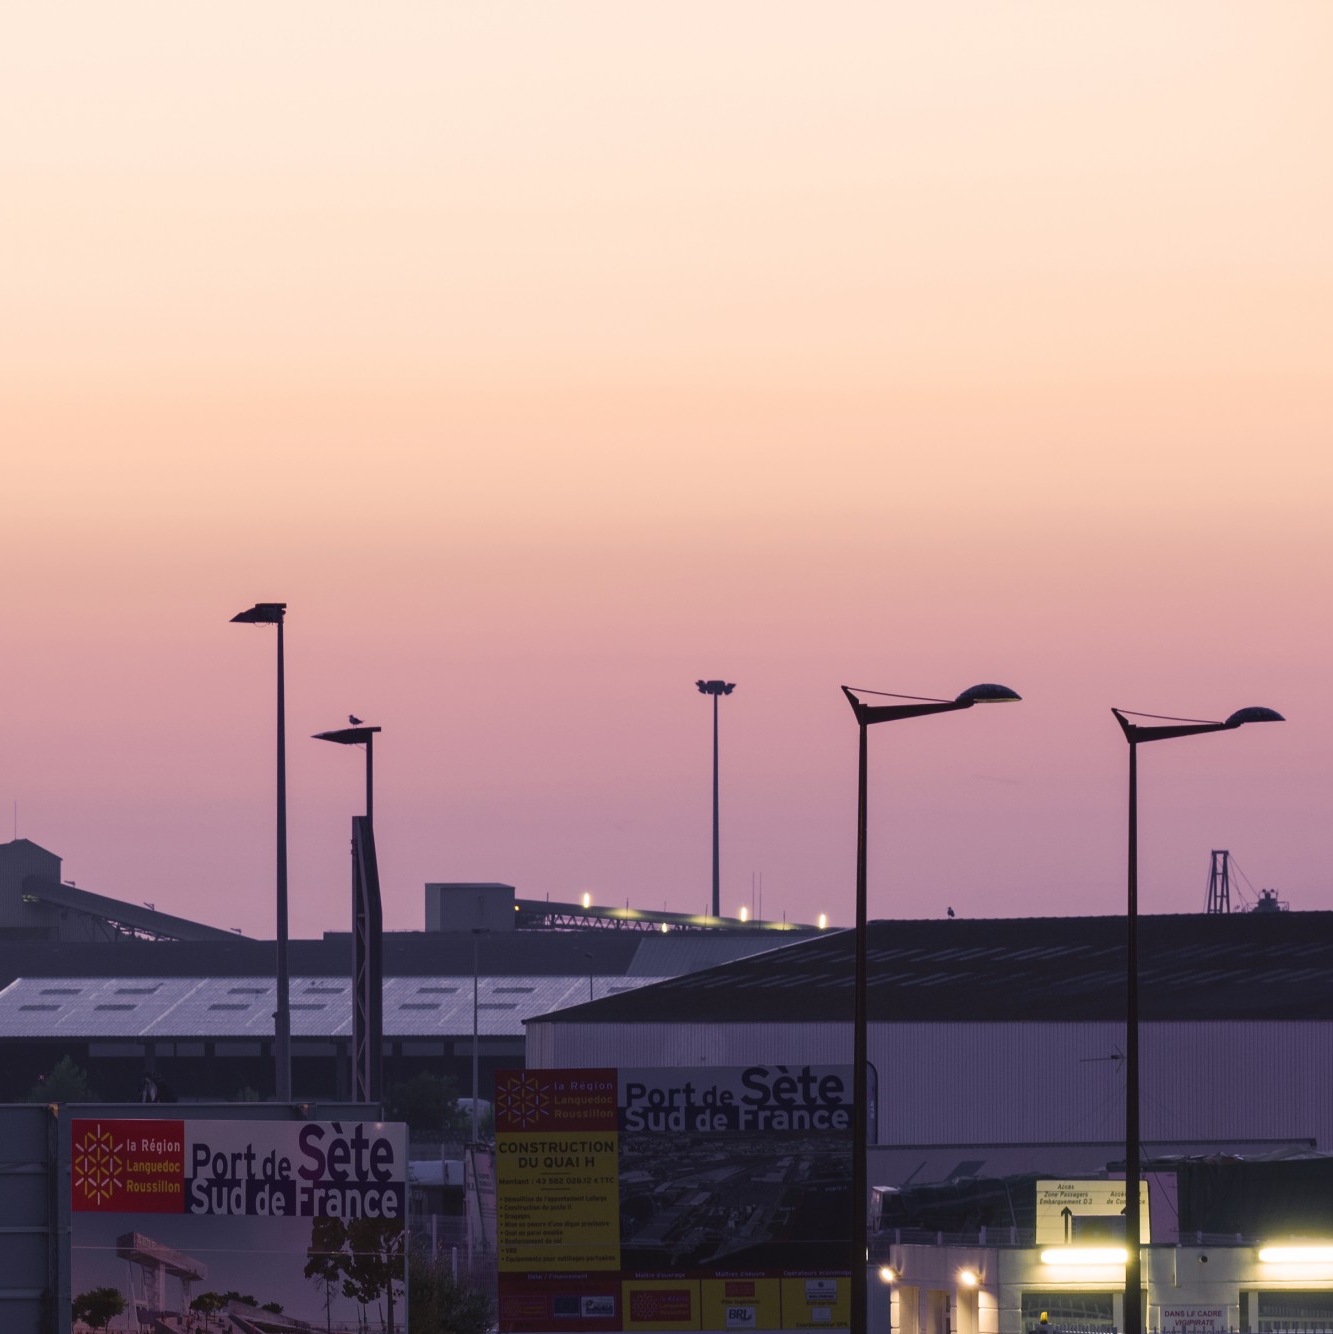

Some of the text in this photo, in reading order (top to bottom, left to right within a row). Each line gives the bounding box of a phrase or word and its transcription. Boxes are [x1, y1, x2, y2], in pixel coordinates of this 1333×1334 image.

[554, 1080, 613, 1092] la Région
[626, 1065, 844, 1107] Port de Sète
[554, 1096, 613, 1106] Languedoc
[554, 1109, 614, 1120] Roussillon
[624, 1106, 686, 1132] Sud
[695, 1109, 728, 1132] de
[739, 1105, 849, 1131] France
[127, 1138, 180, 1155] la Région
[193, 1123, 394, 1181] Port de Sète
[498, 1141, 614, 1153] CONSTRUCTION
[127, 1159, 180, 1174] Languedoc
[518, 1156, 595, 1168] DU QUAI H
[126, 1180, 180, 1193] Roussillon
[190, 1178, 398, 1218] Sud de France
[1060, 1191, 1089, 1199] Passagers
[728, 1309, 752, 1321] BRL
[1164, 1310, 1185, 1318] DANS
